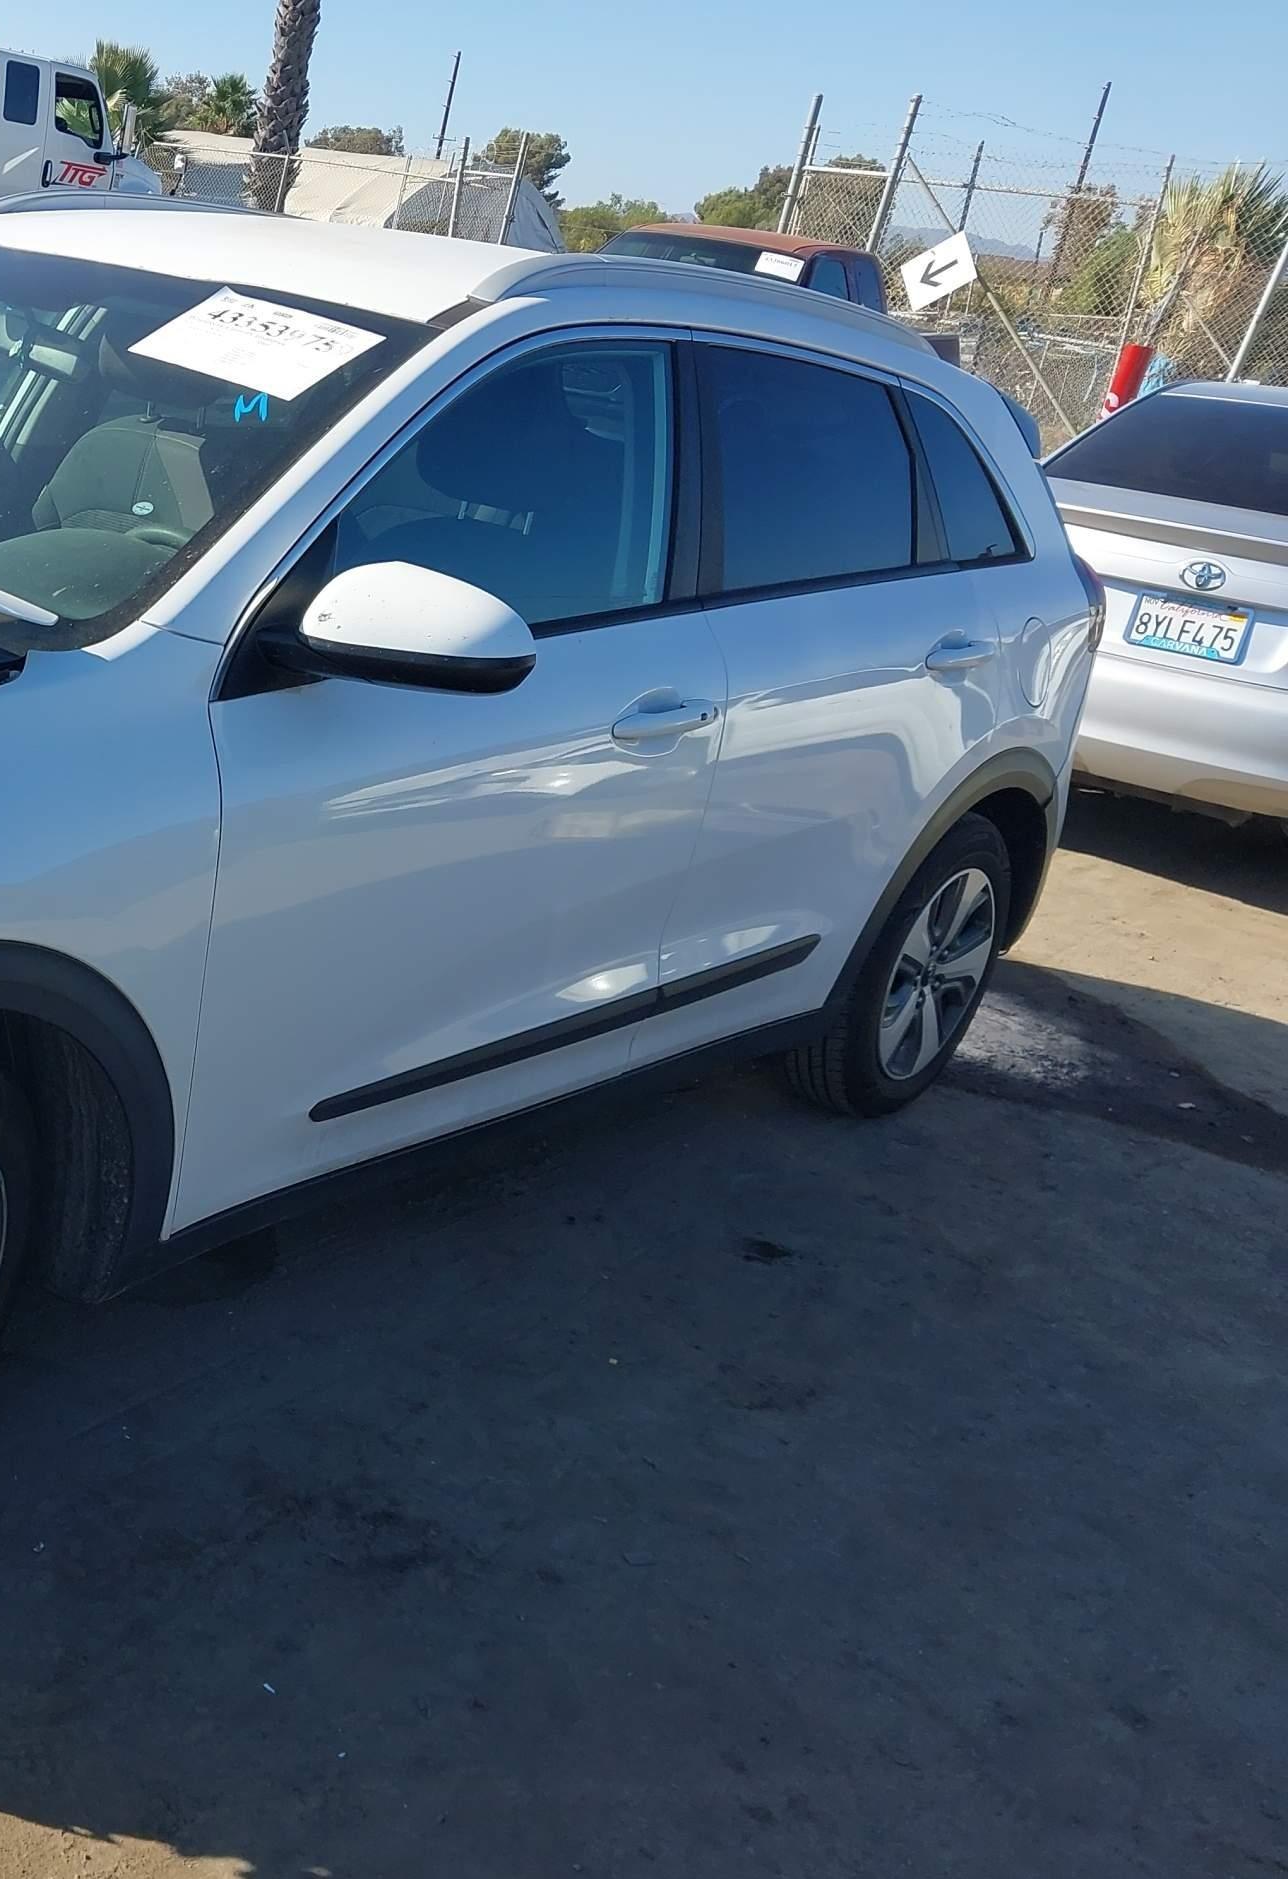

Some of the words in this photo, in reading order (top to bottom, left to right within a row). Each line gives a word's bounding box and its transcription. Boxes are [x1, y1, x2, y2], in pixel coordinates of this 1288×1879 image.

[59, 160, 107, 187] TTG
[1135, 612, 1238, 652] 8YLF475
[1151, 638, 1207, 657] CARVANA
